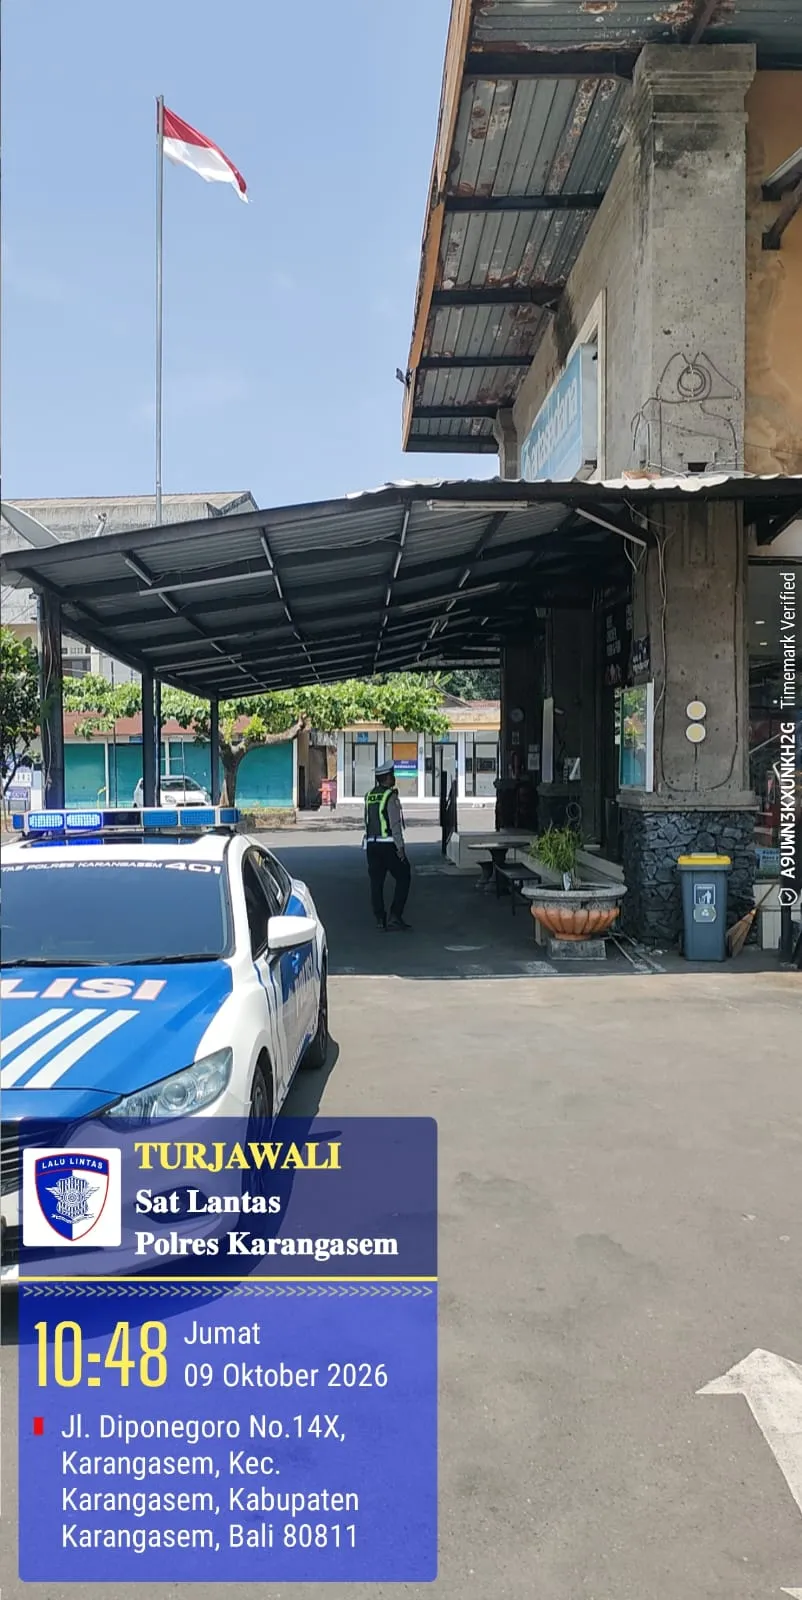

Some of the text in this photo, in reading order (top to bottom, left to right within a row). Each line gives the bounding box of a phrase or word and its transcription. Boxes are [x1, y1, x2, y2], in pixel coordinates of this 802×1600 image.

[26, 862, 76, 871] POLRES
[78, 861, 163, 869] KARANGASEM
[164, 862, 222, 875] 401
